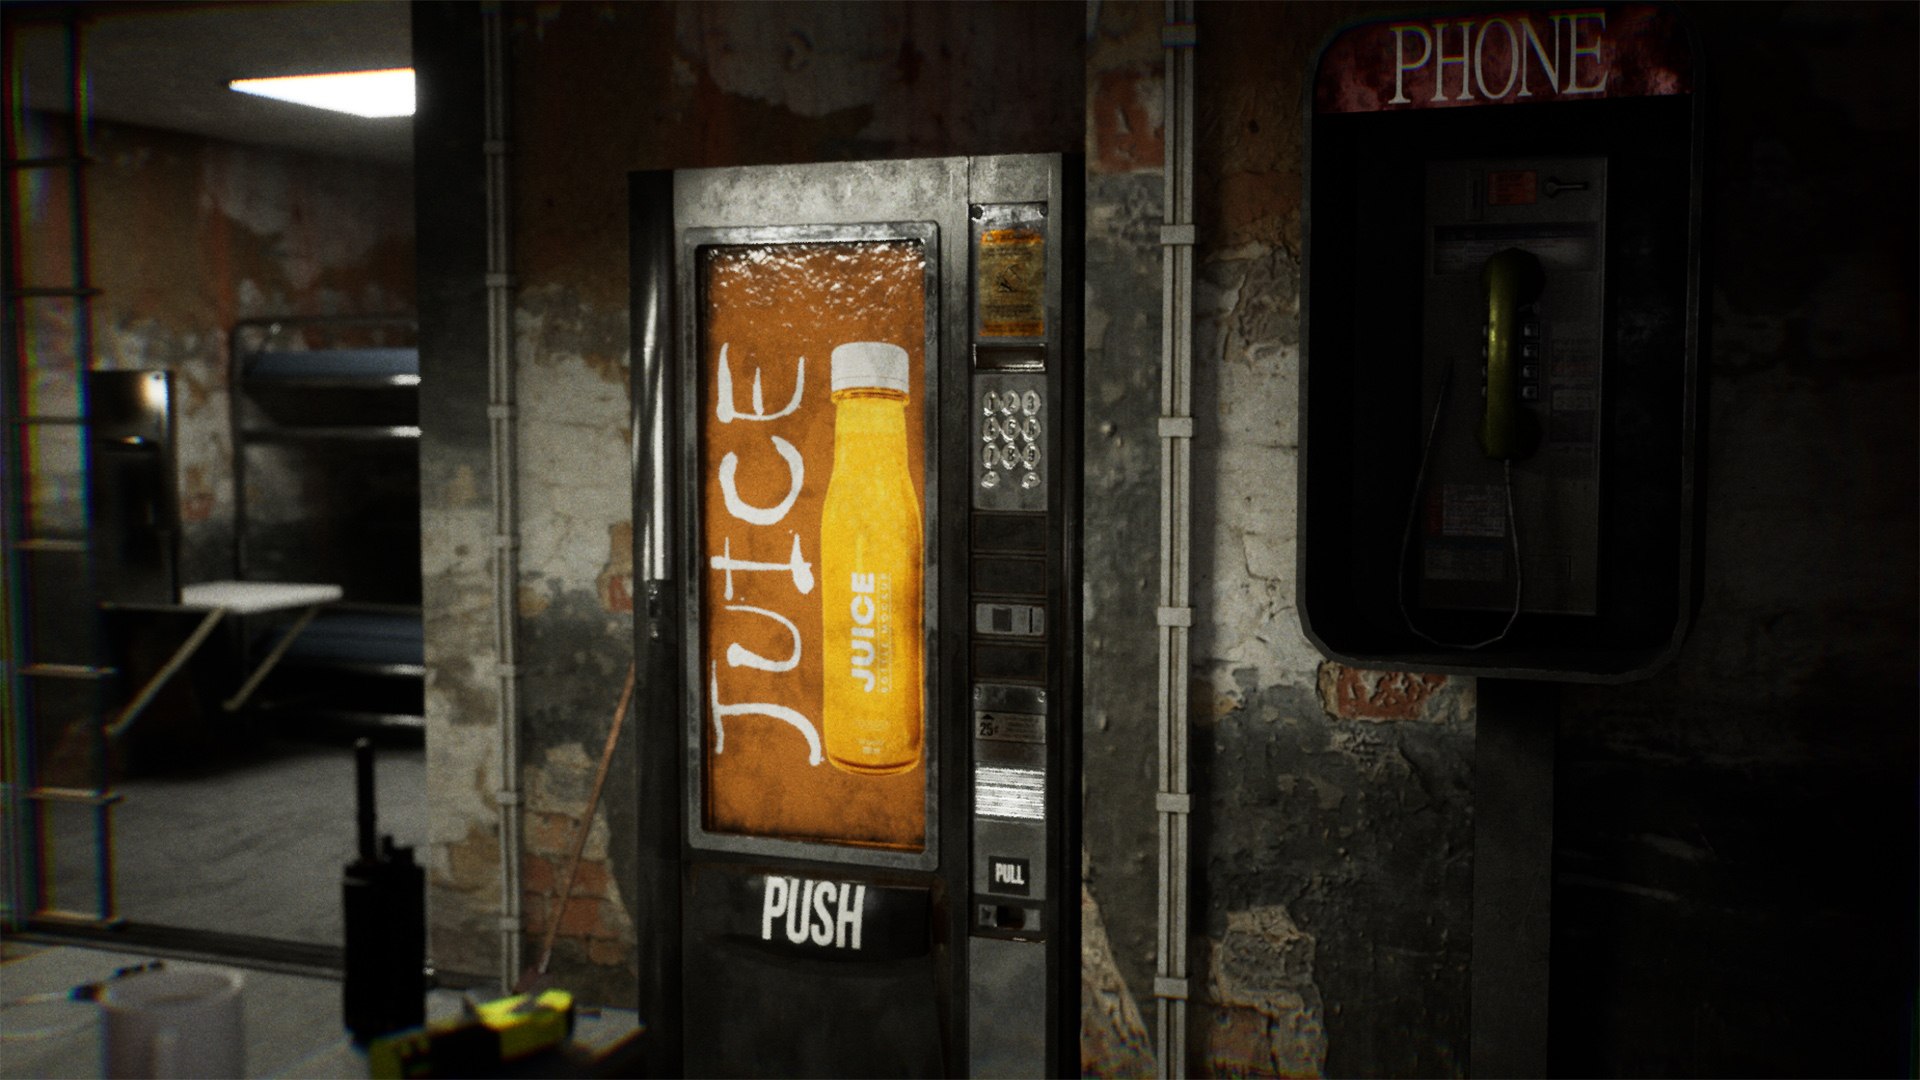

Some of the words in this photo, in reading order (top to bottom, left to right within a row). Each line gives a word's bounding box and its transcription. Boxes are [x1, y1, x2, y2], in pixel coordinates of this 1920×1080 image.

[1388, 9, 1609, 104] PHONE
[711, 342, 825, 766] JUICE
[850, 572, 875, 692] JUICE
[762, 875, 866, 949] PUSH
[995, 862, 1024, 885] PULL
